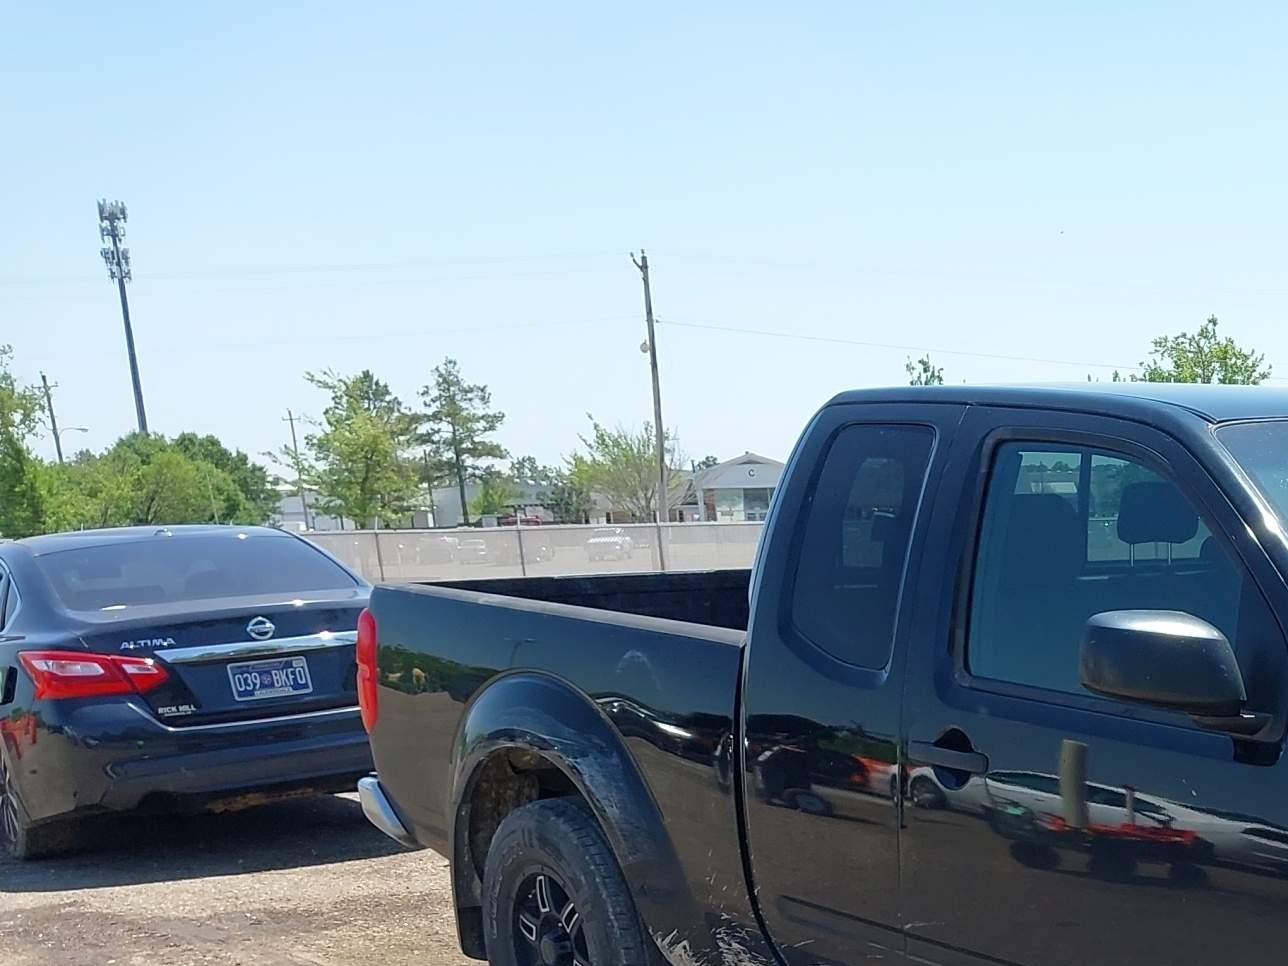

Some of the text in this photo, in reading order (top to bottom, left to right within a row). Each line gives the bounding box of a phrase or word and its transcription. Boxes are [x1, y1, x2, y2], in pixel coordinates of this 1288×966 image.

[748, 469, 755, 477] C
[120, 638, 176, 649] ALTIMA
[235, 673, 260, 692] 039
